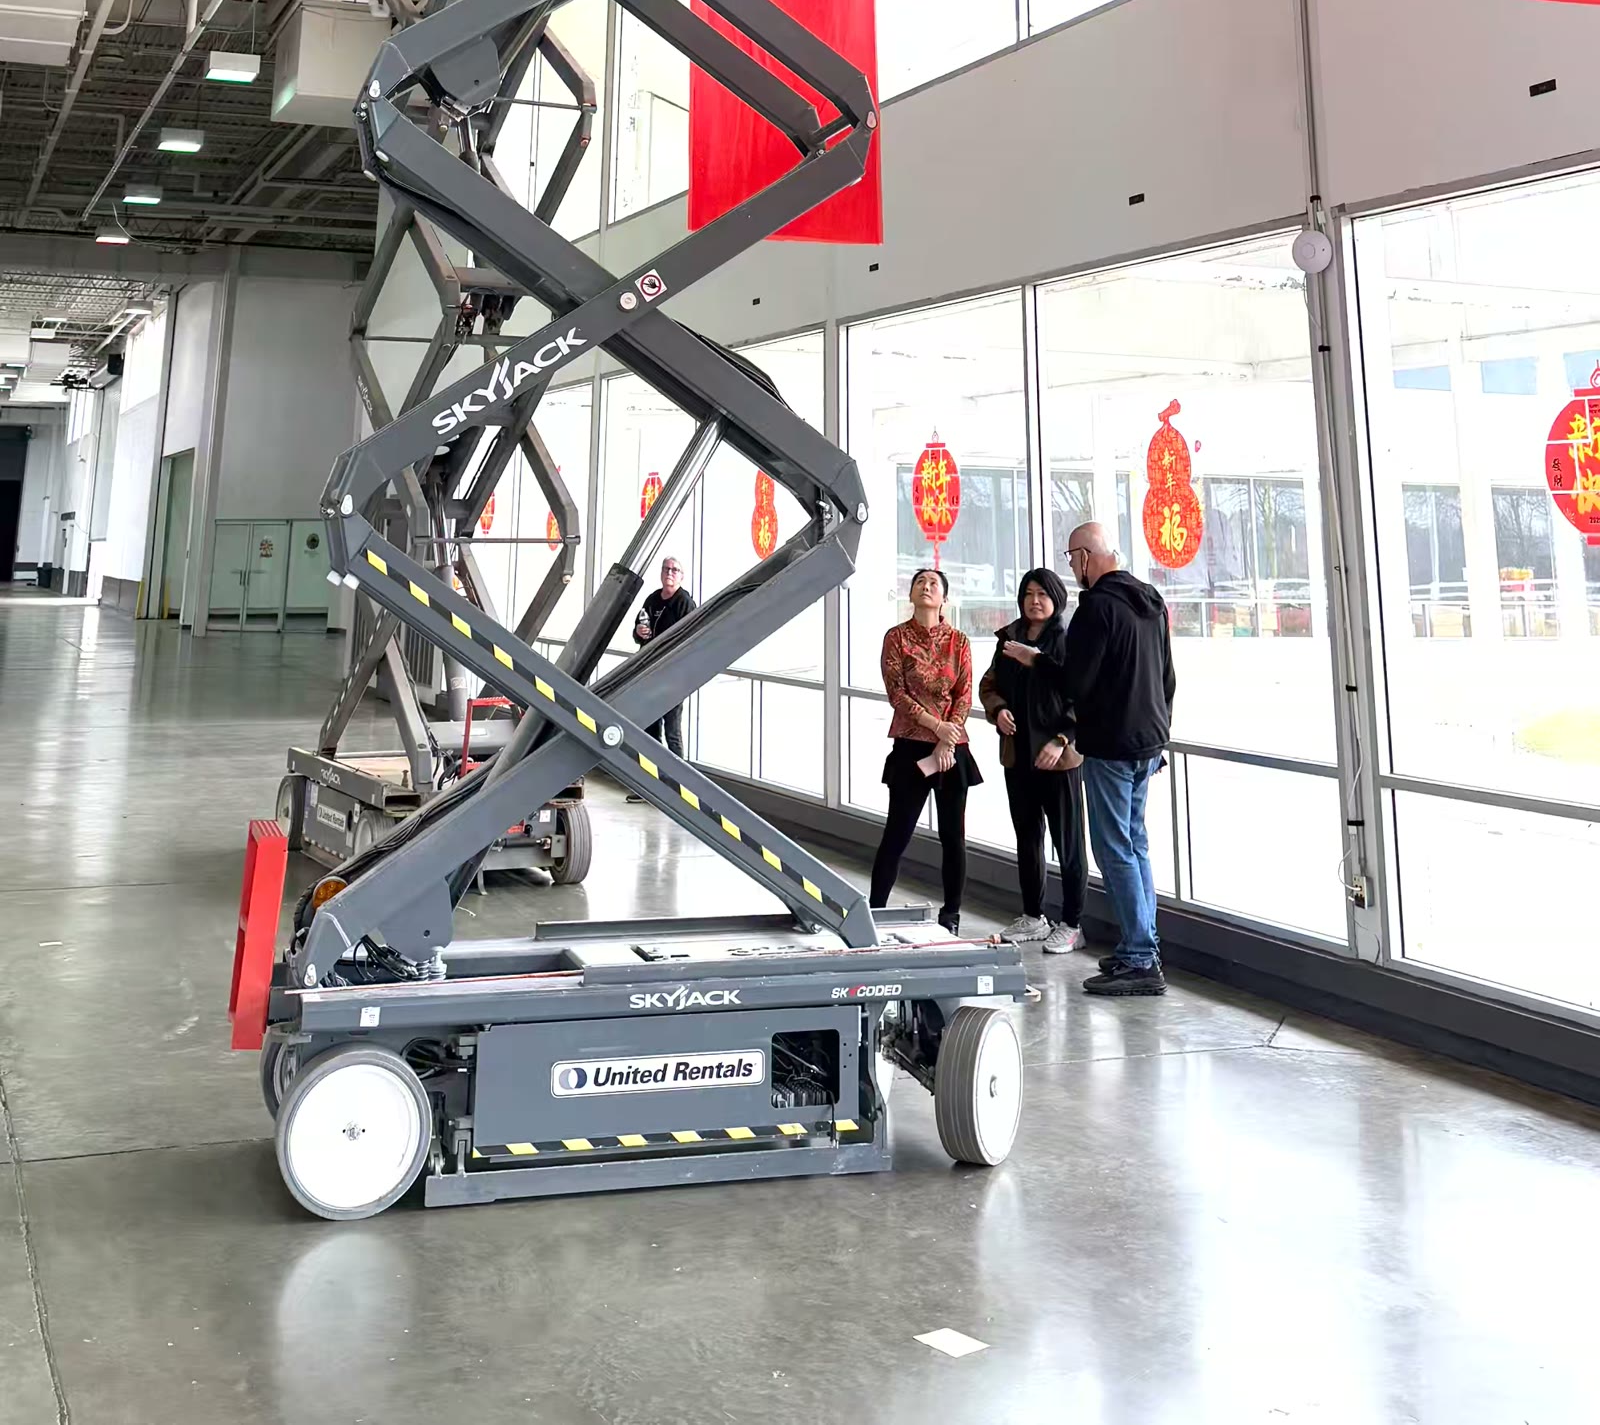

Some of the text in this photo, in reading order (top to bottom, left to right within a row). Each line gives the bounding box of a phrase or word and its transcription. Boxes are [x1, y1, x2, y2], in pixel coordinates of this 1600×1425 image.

[431, 326, 588, 435] SKYJACK
[1160, 502, 1188, 560] 福
[629, 984, 742, 1011] SKYJACK
[593, 1058, 754, 1087] United Rentals
